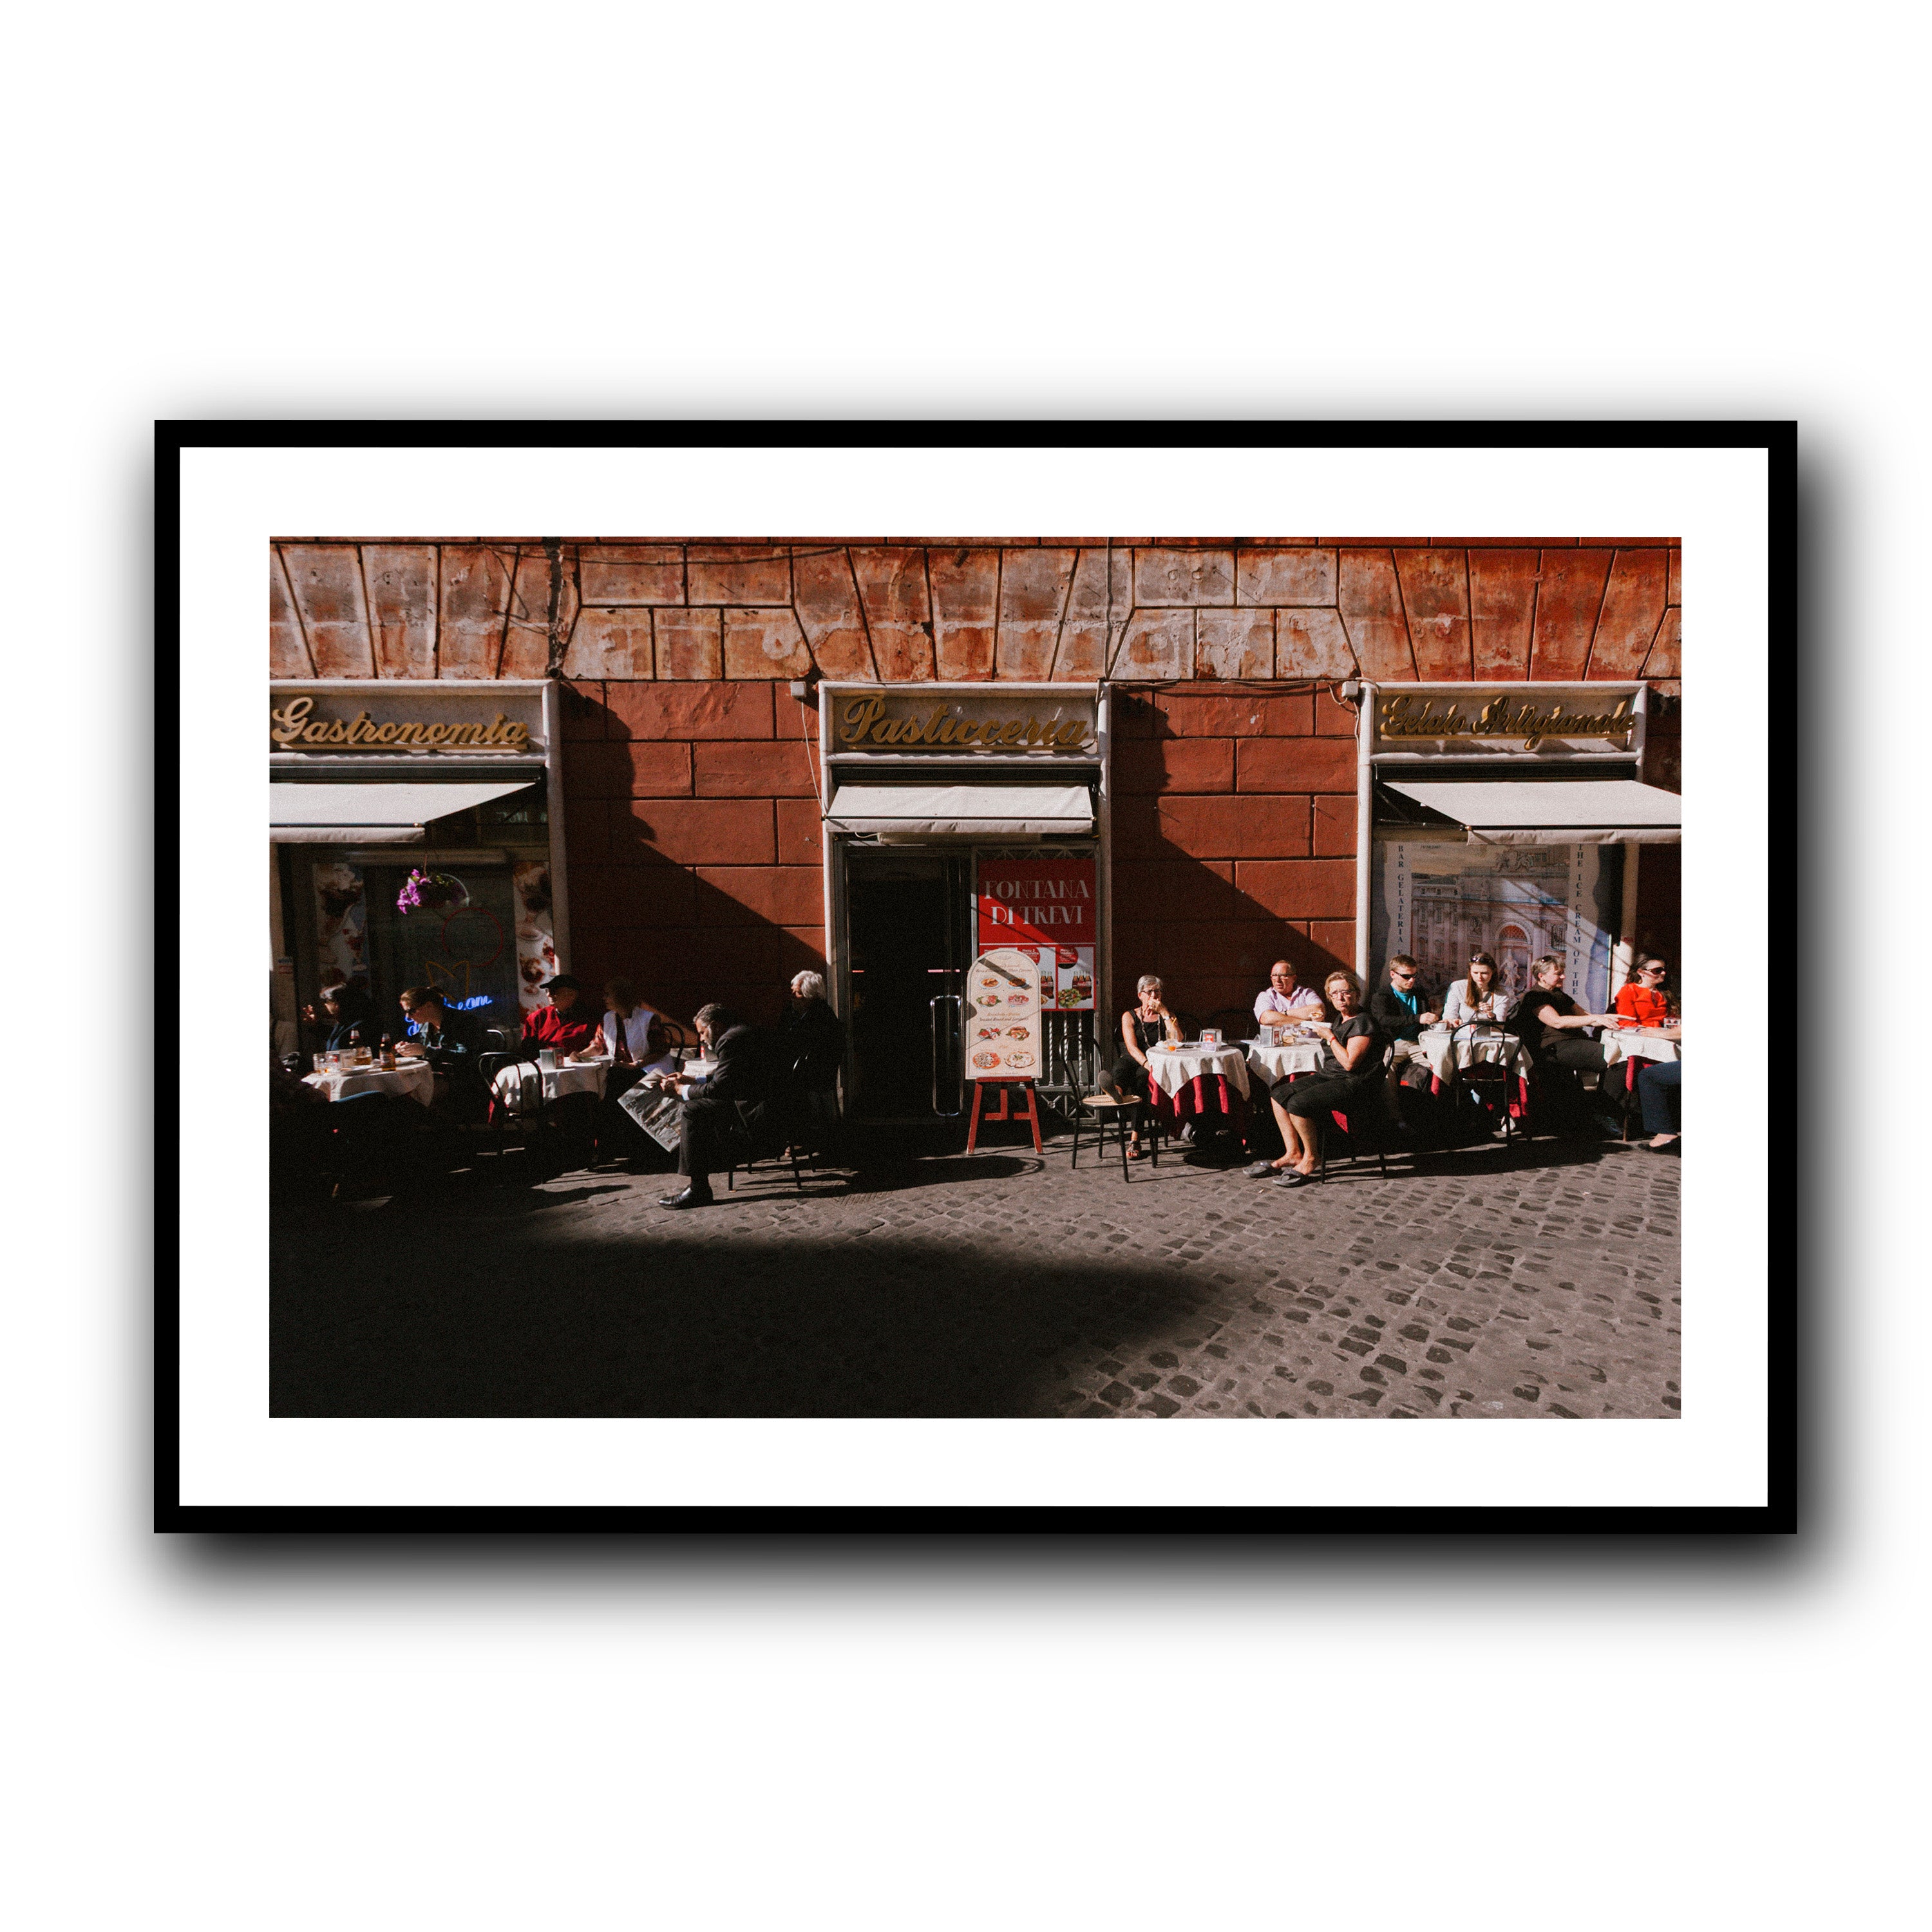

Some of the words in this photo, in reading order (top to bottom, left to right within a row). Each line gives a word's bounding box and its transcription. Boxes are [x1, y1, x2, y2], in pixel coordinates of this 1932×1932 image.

[272, 697, 531, 743] Gastronomia
[839, 695, 1089, 745] Pasticceria
[1380, 694, 1467, 735] Gelato
[1471, 696, 1636, 750] Artigianale
[984, 880, 1090, 899] FONTANA
[990, 906, 1014, 925] DI
[1019, 906, 1084, 925] TREVI
[1573, 904, 1582, 943] CREAM
[1573, 950, 1580, 965] OF
